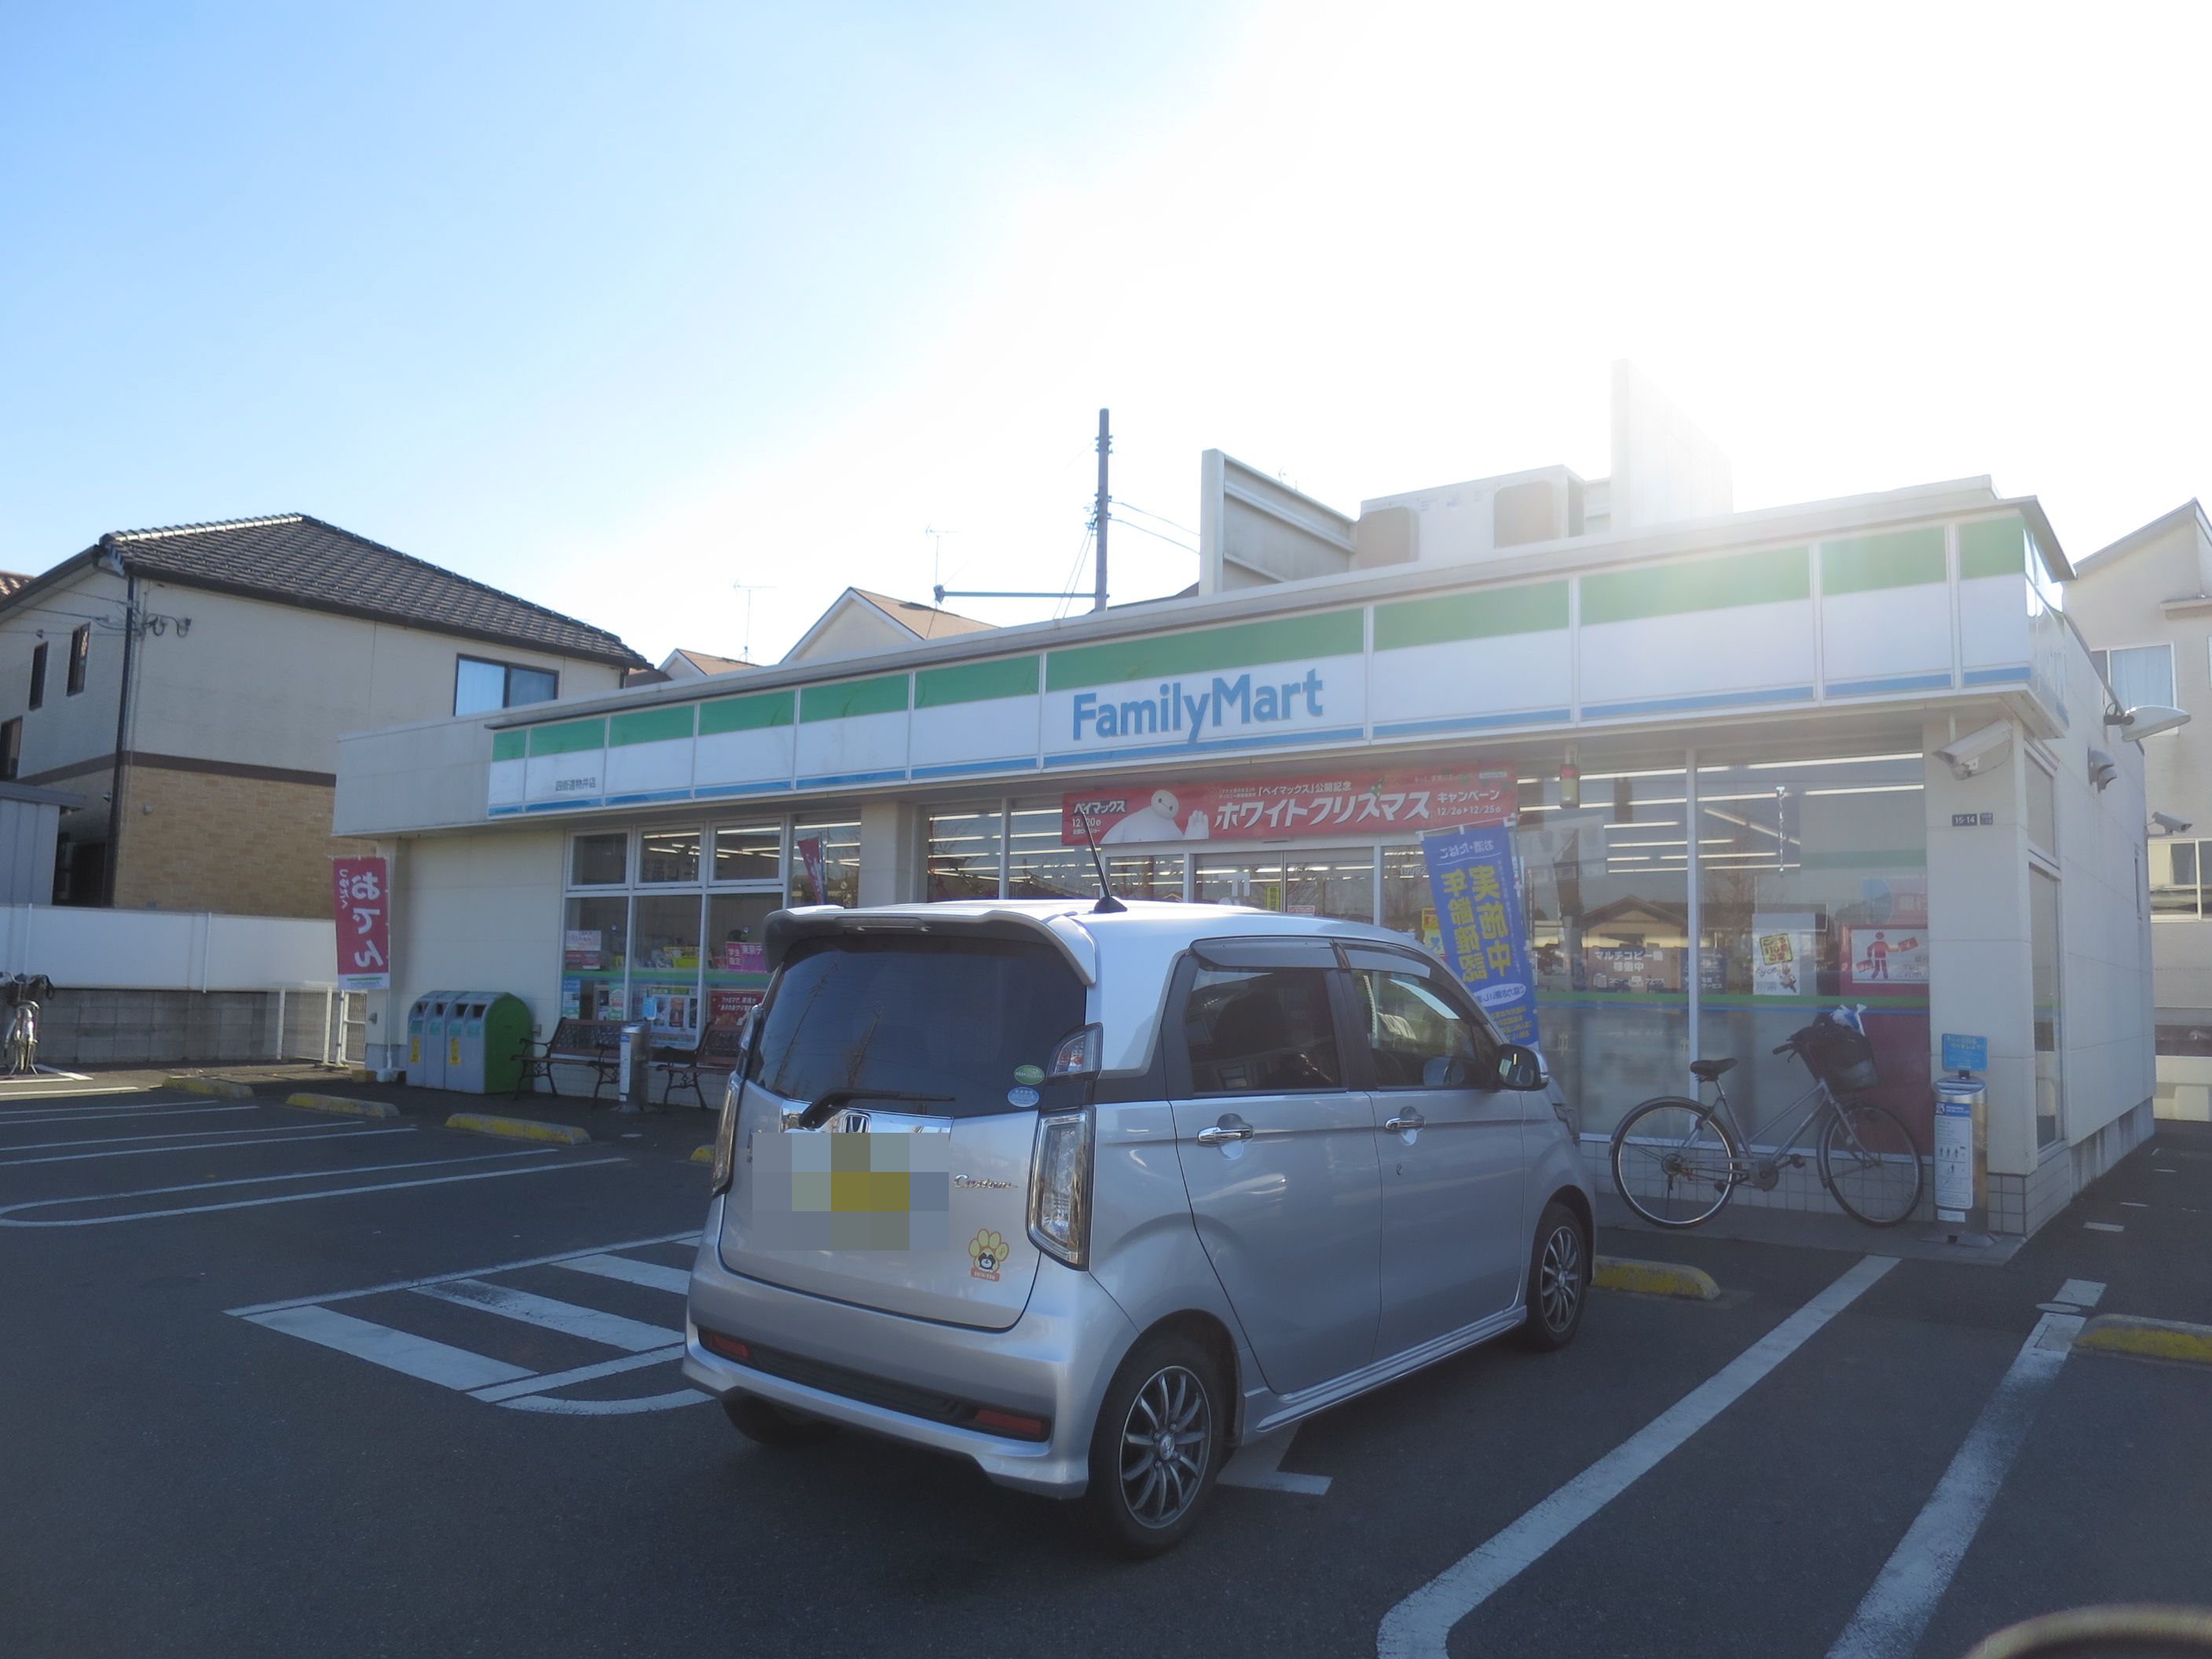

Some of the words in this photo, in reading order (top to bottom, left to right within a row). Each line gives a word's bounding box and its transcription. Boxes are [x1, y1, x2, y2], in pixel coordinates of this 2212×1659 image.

[1073, 668, 1324, 745] FamilyMart
[1258, 782, 1352, 797] 「ベイマックス」公開記念
[1437, 789, 1500, 803] キャンペーン
[1074, 800, 1126, 815] ベイマックス
[1214, 791, 1431, 830] ホワイトクリスマス
[953, 1174, 1019, 1189] Custom
